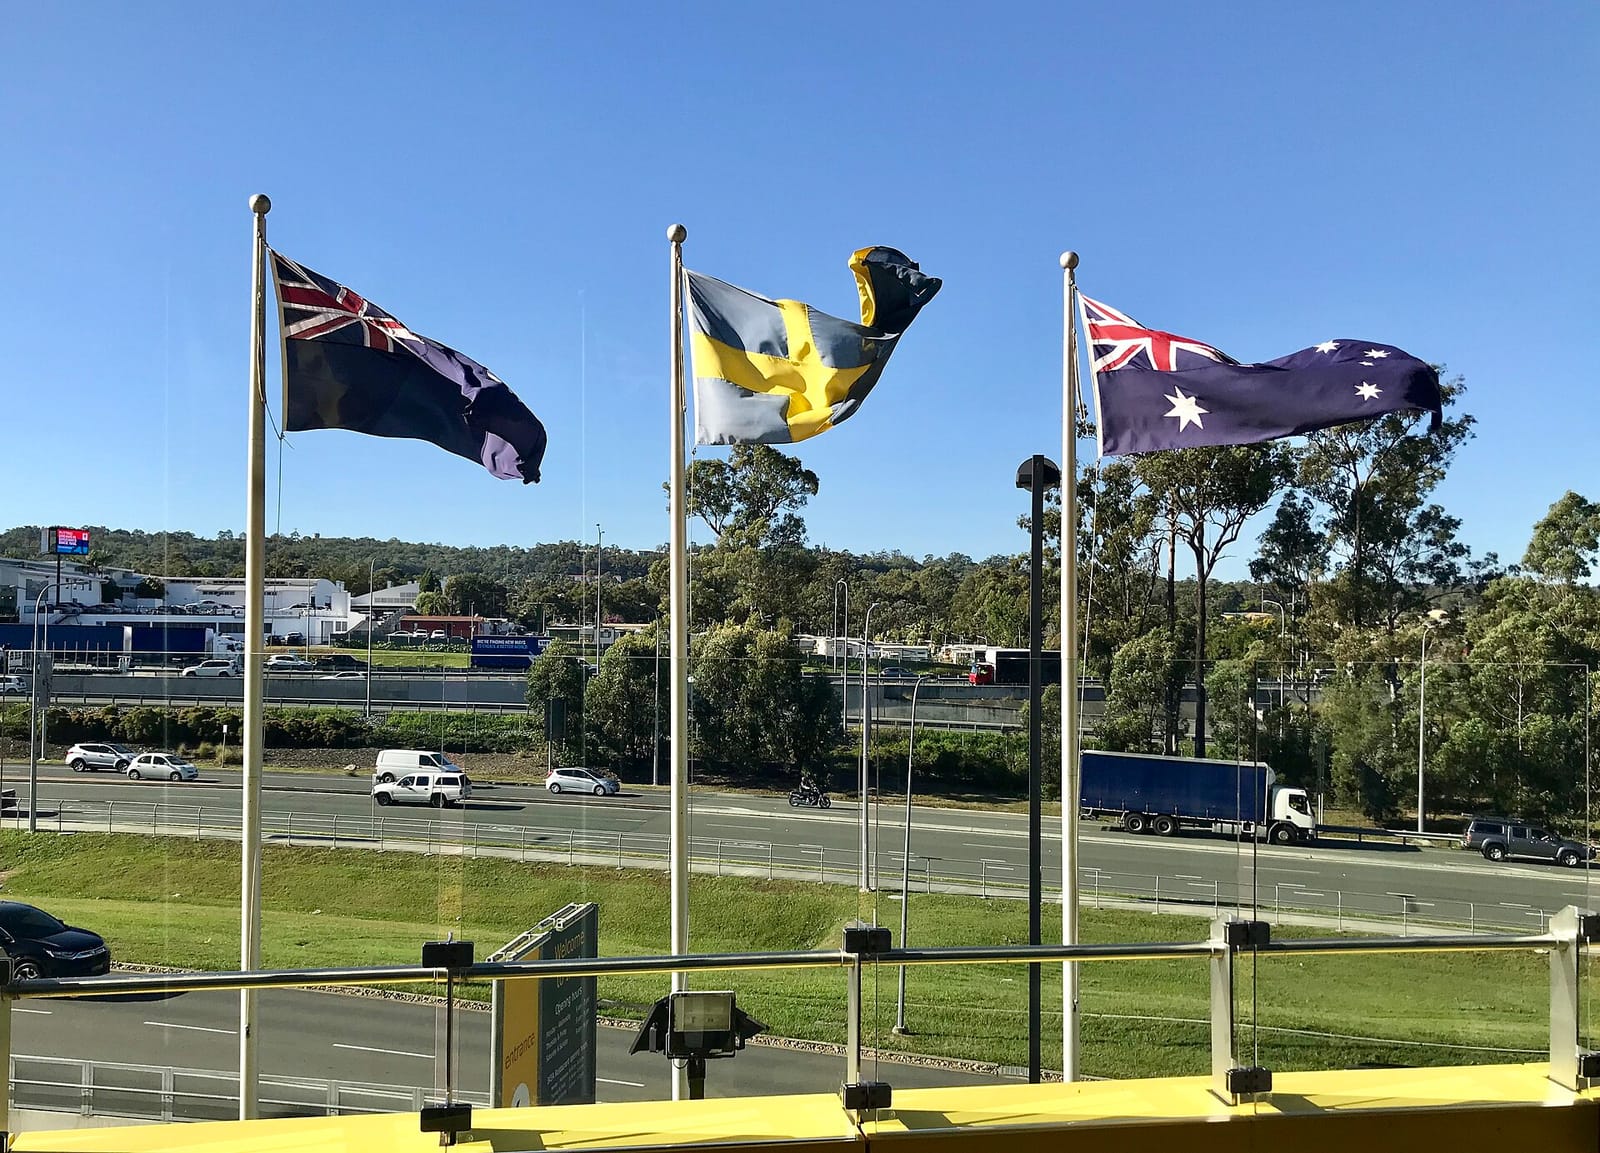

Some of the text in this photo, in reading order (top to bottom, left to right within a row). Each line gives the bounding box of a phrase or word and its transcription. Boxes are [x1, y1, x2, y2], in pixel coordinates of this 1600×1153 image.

[554, 931, 585, 960] Welcome
[554, 995, 571, 1016] Opening
[571, 986, 583, 1001] hours
[504, 1032, 536, 1070] entrance
